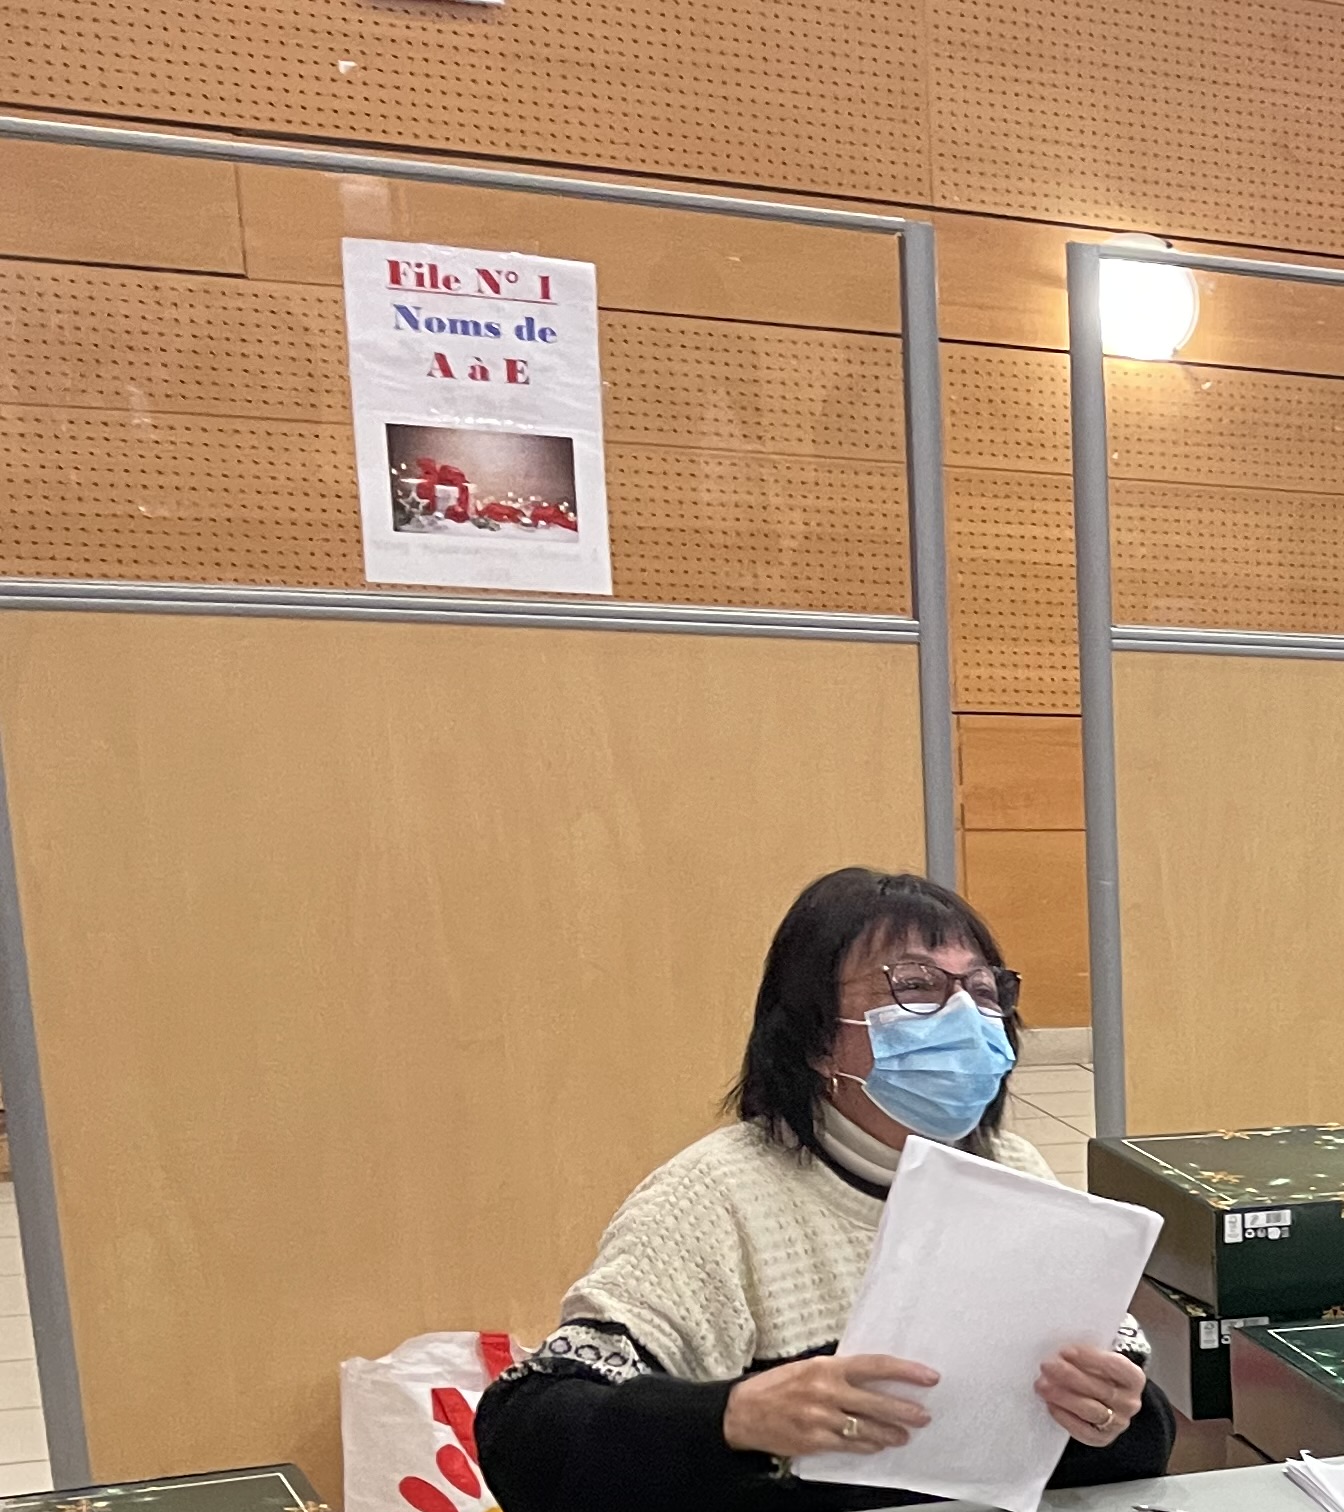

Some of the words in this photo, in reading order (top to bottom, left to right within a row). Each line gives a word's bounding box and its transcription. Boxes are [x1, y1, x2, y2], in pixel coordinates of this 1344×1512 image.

[386, 258, 462, 292] File
[475, 267, 519, 295] N°
[538, 275, 551, 300] 1
[392, 303, 502, 339] Noms
[514, 316, 558, 344] de
[426, 351, 457, 380] A
[467, 355, 491, 382] à
[503, 357, 531, 385] E
